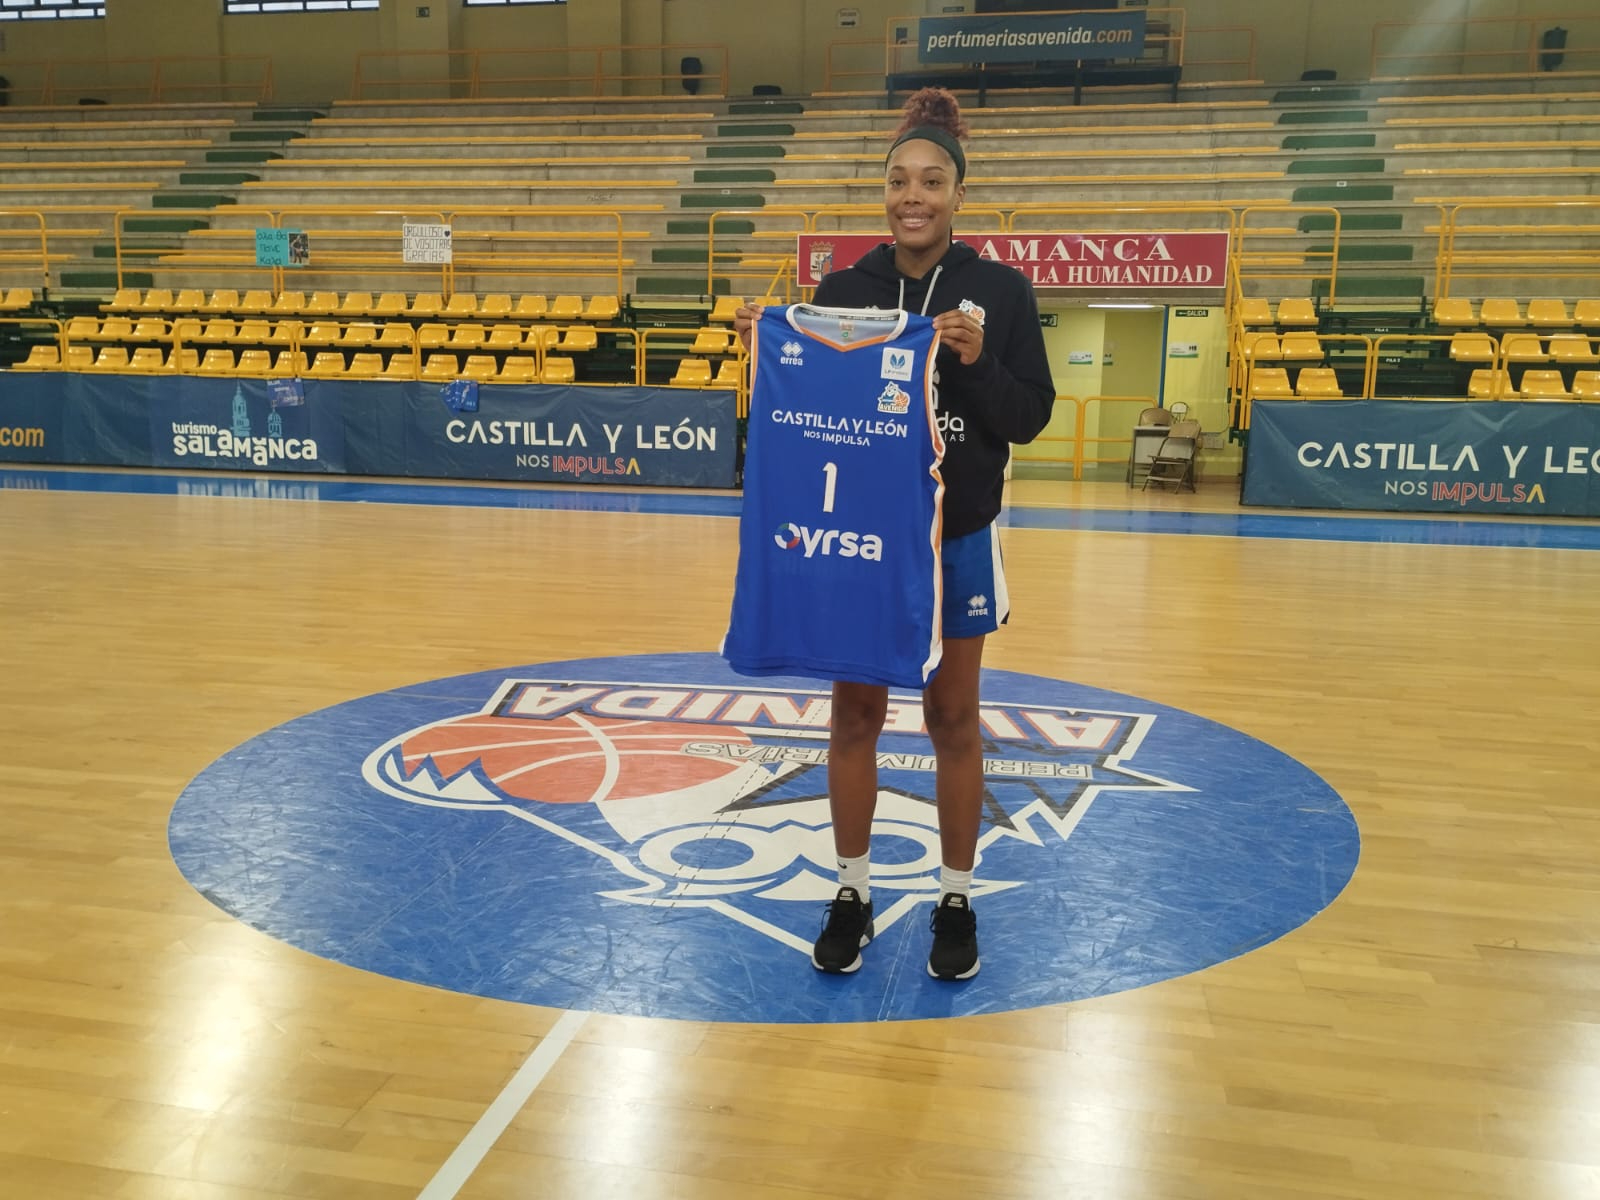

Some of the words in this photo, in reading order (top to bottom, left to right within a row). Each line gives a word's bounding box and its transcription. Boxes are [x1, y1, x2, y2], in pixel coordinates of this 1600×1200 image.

[927, 27, 1132, 52] perfumeriasavenida.com
[405, 250, 445, 262] GRACIAS
[979, 239, 1174, 262] AMANCA
[1032, 265, 1060, 284] LA
[1067, 264, 1213, 284] HUMANIDAD
[172, 421, 217, 435] turismo
[446, 419, 587, 447] CASTILLA
[602, 423, 623, 453] Y
[636, 417, 716, 451] LEÓN
[771, 409, 849, 432] CASTILLA
[852, 418, 863, 434] Y
[865, 418, 908, 438] LEÓN
[803, 430, 821, 439] NOS
[822, 432, 870, 447] IMPULSA
[516, 454, 550, 468] NOS
[552, 455, 641, 477] IMPULSA
[1297, 441, 1480, 472] CASTILLA
[1502, 445, 1529, 479] Y
[822, 461, 838, 513] 1
[1384, 480, 1427, 496] NOS
[1432, 482, 1545, 506] IMPULSA
